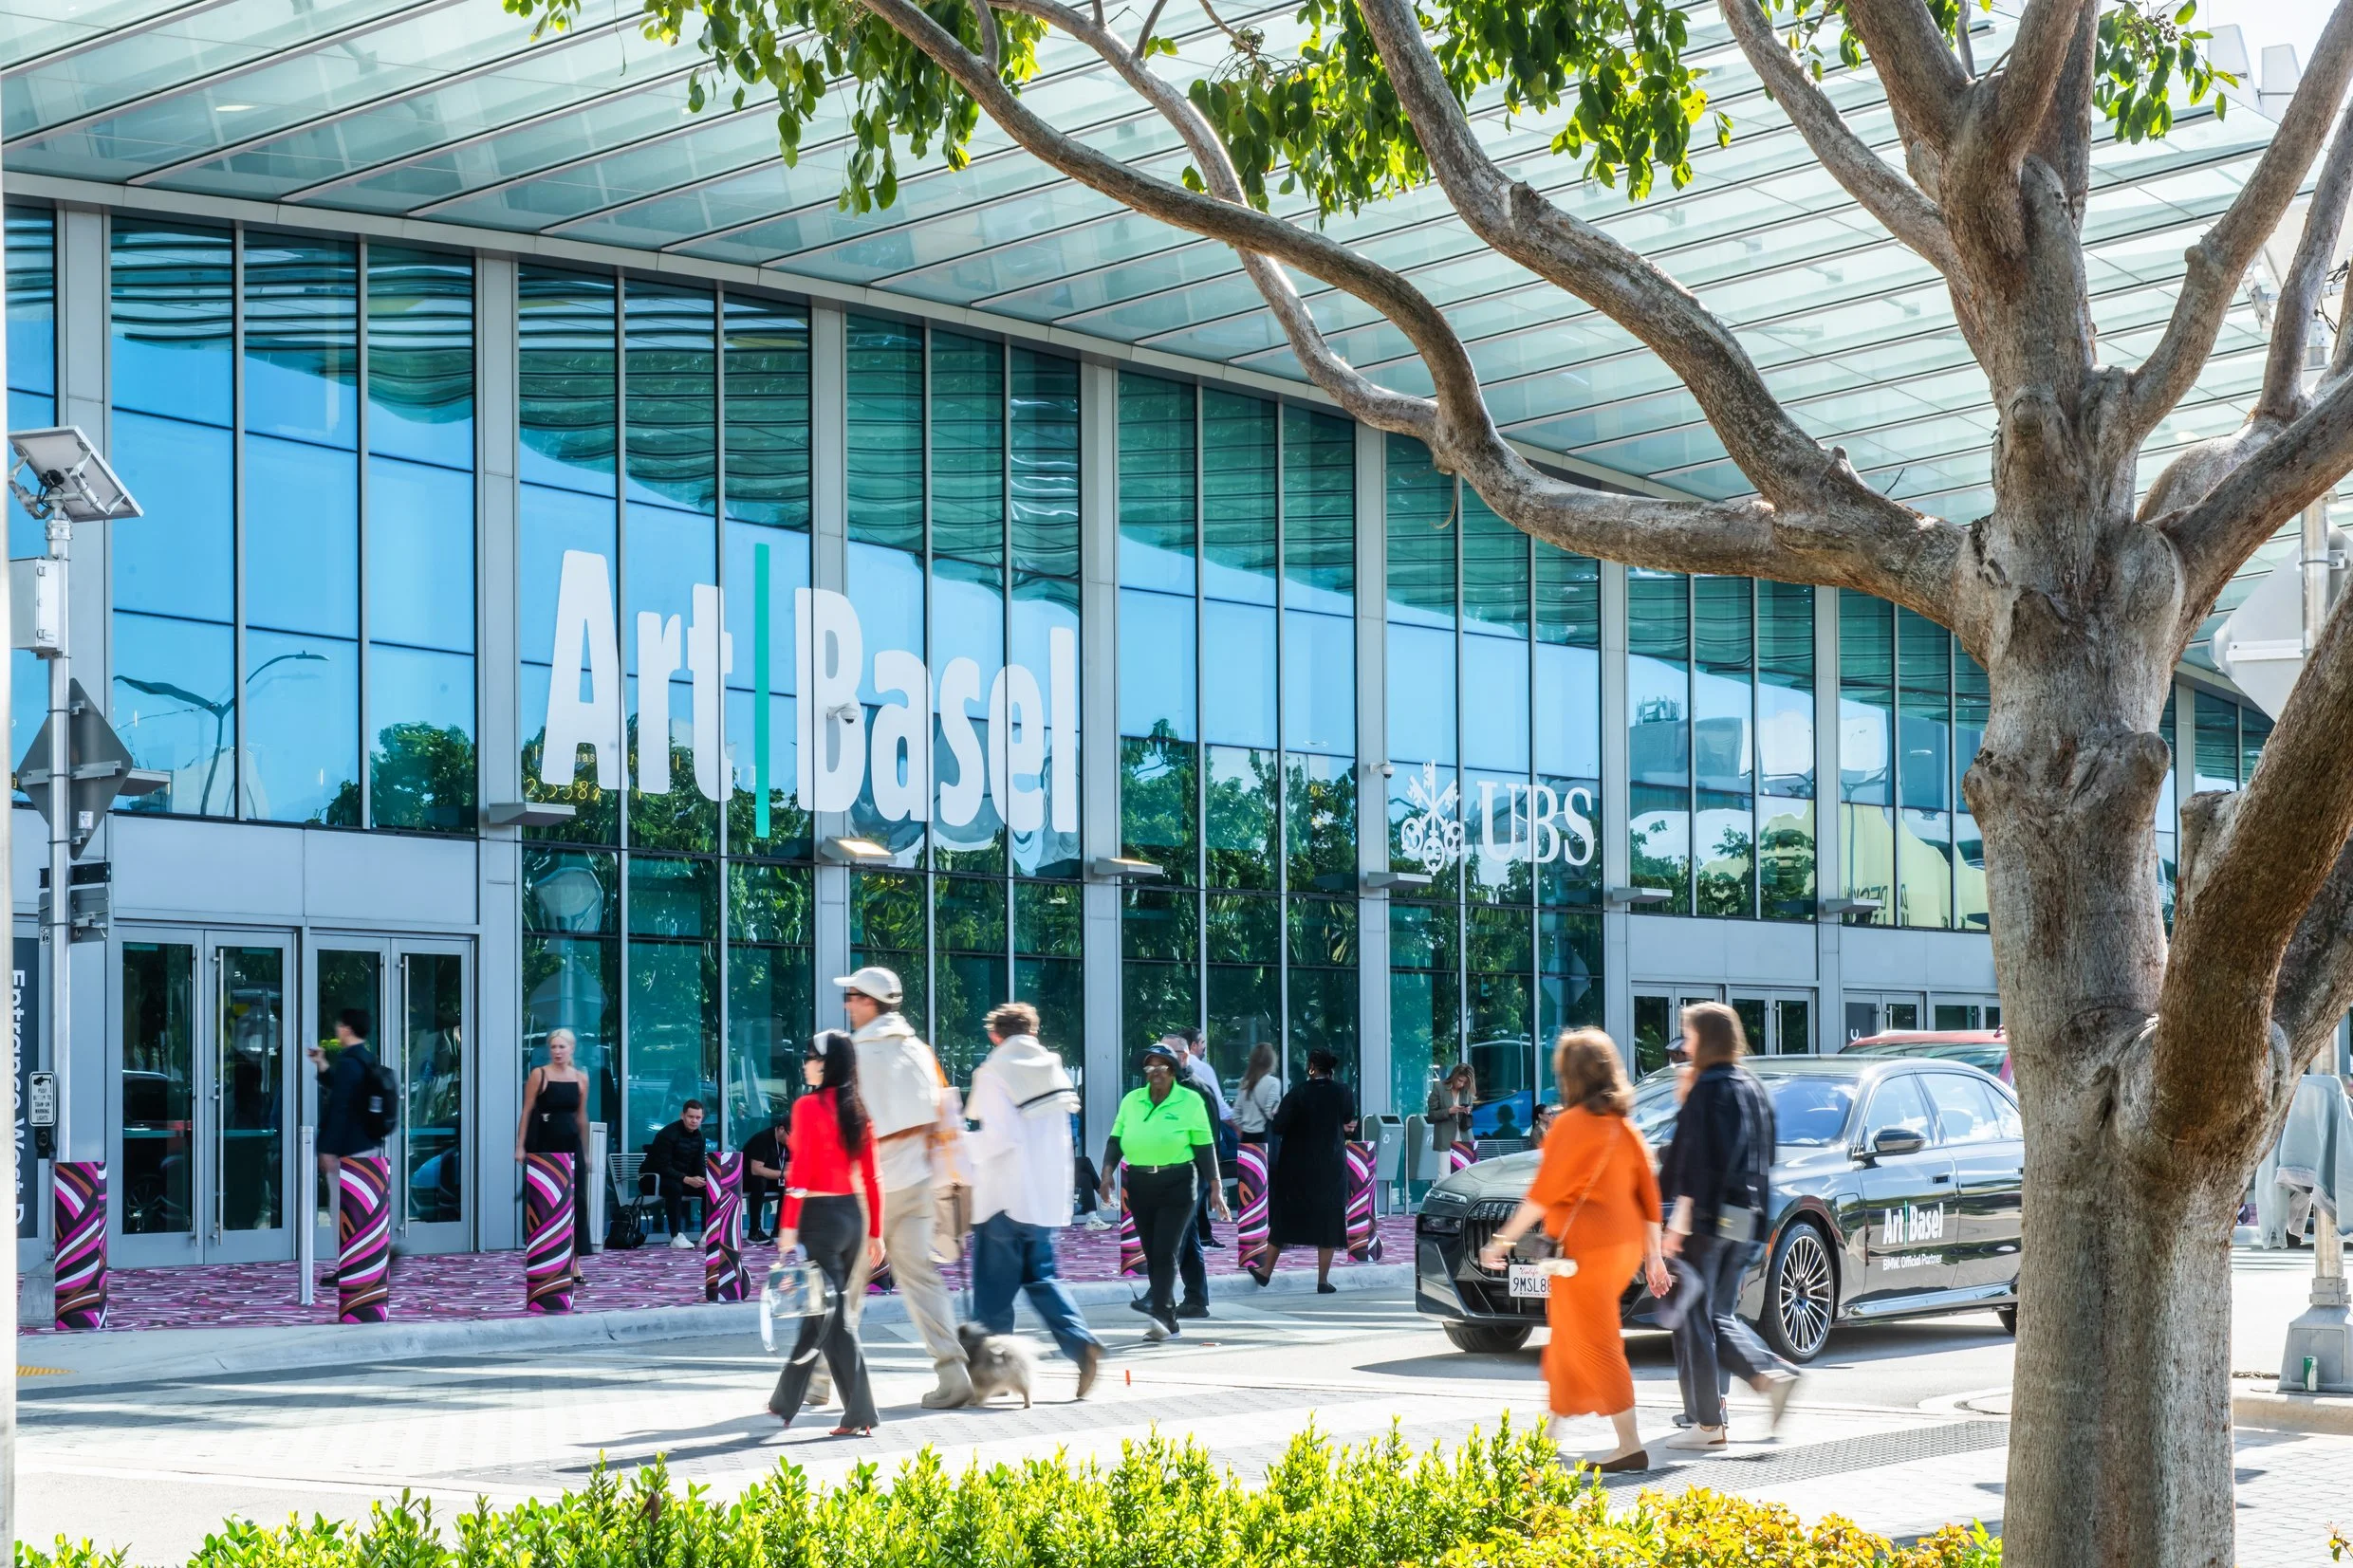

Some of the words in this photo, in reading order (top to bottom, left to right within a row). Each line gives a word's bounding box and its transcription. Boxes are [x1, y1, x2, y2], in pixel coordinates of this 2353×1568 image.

[541, 549, 733, 802] Art
[795, 588, 1077, 833] Basel
[1476, 781, 1595, 866] UBS
[1882, 1208, 1904, 1245] Art
[1908, 1202, 1944, 1242] Basel
[1900, 1255, 1921, 1268] Official
[1921, 1253, 1943, 1265] Partner
